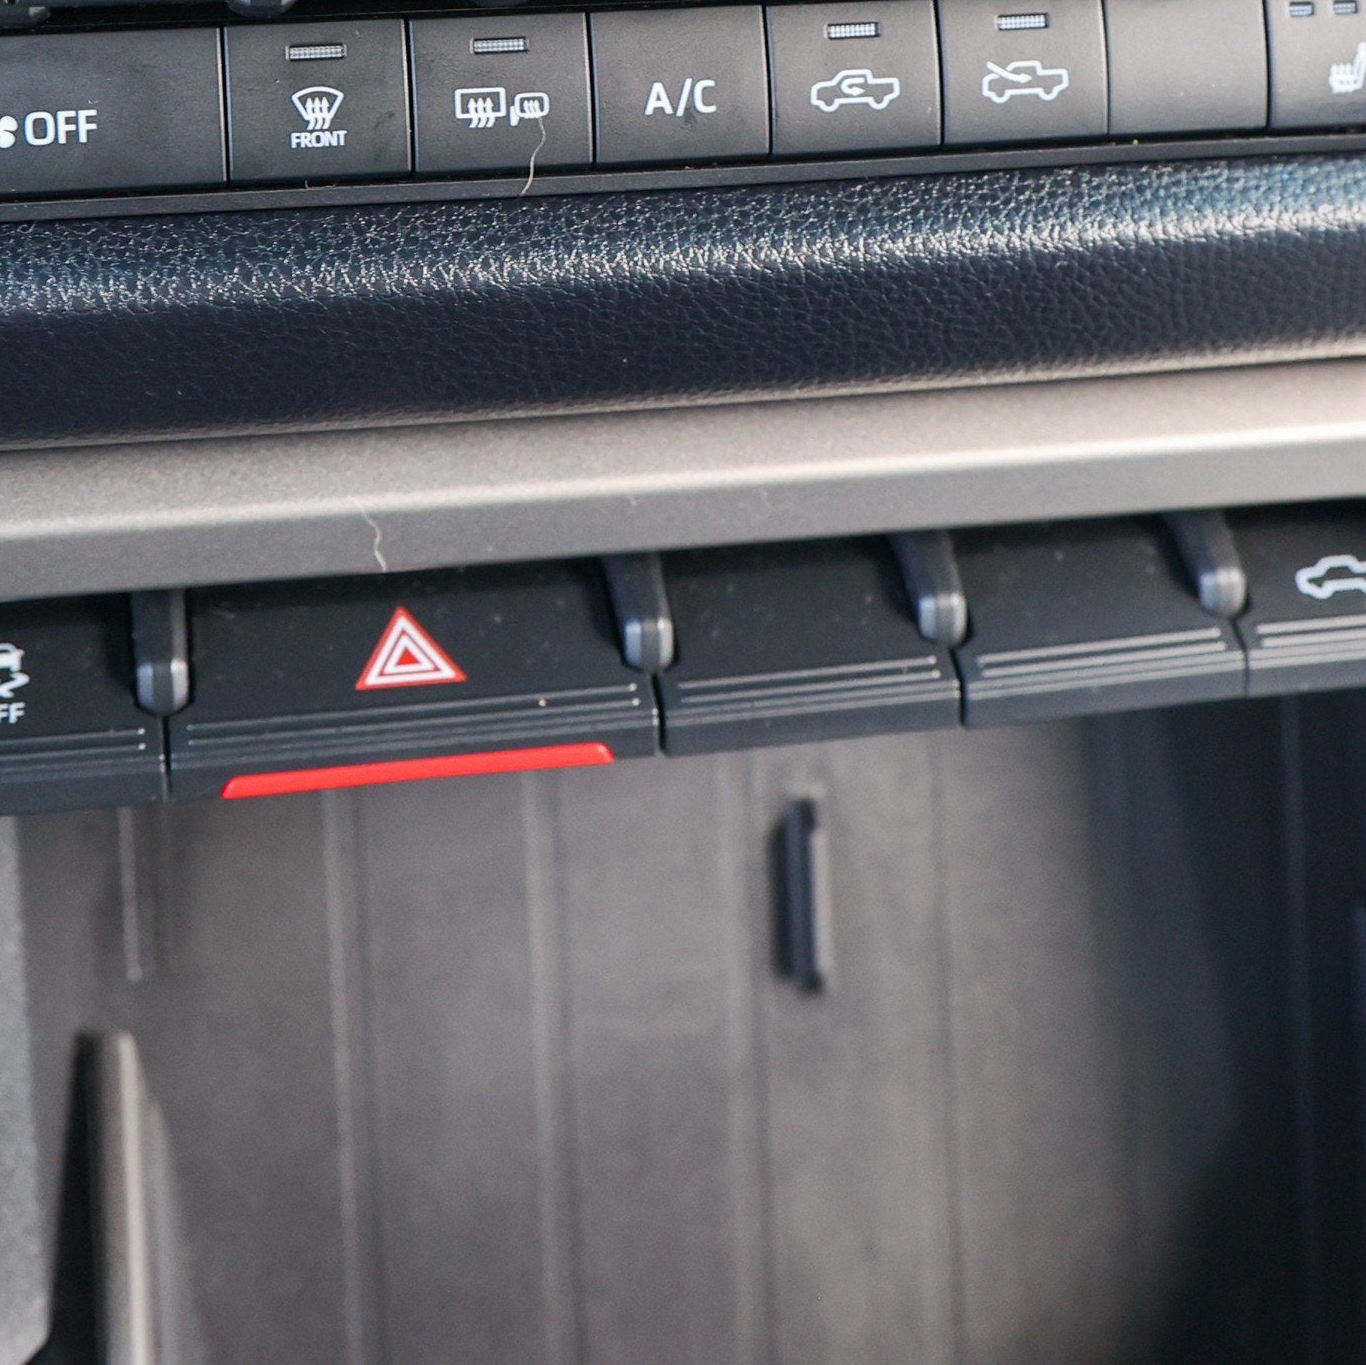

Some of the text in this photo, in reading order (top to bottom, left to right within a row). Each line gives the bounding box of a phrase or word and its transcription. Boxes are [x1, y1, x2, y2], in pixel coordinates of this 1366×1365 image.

[645, 78, 716, 116] A/C
[25, 110, 97, 145] OFF
[291, 132, 347, 148] FRONT
